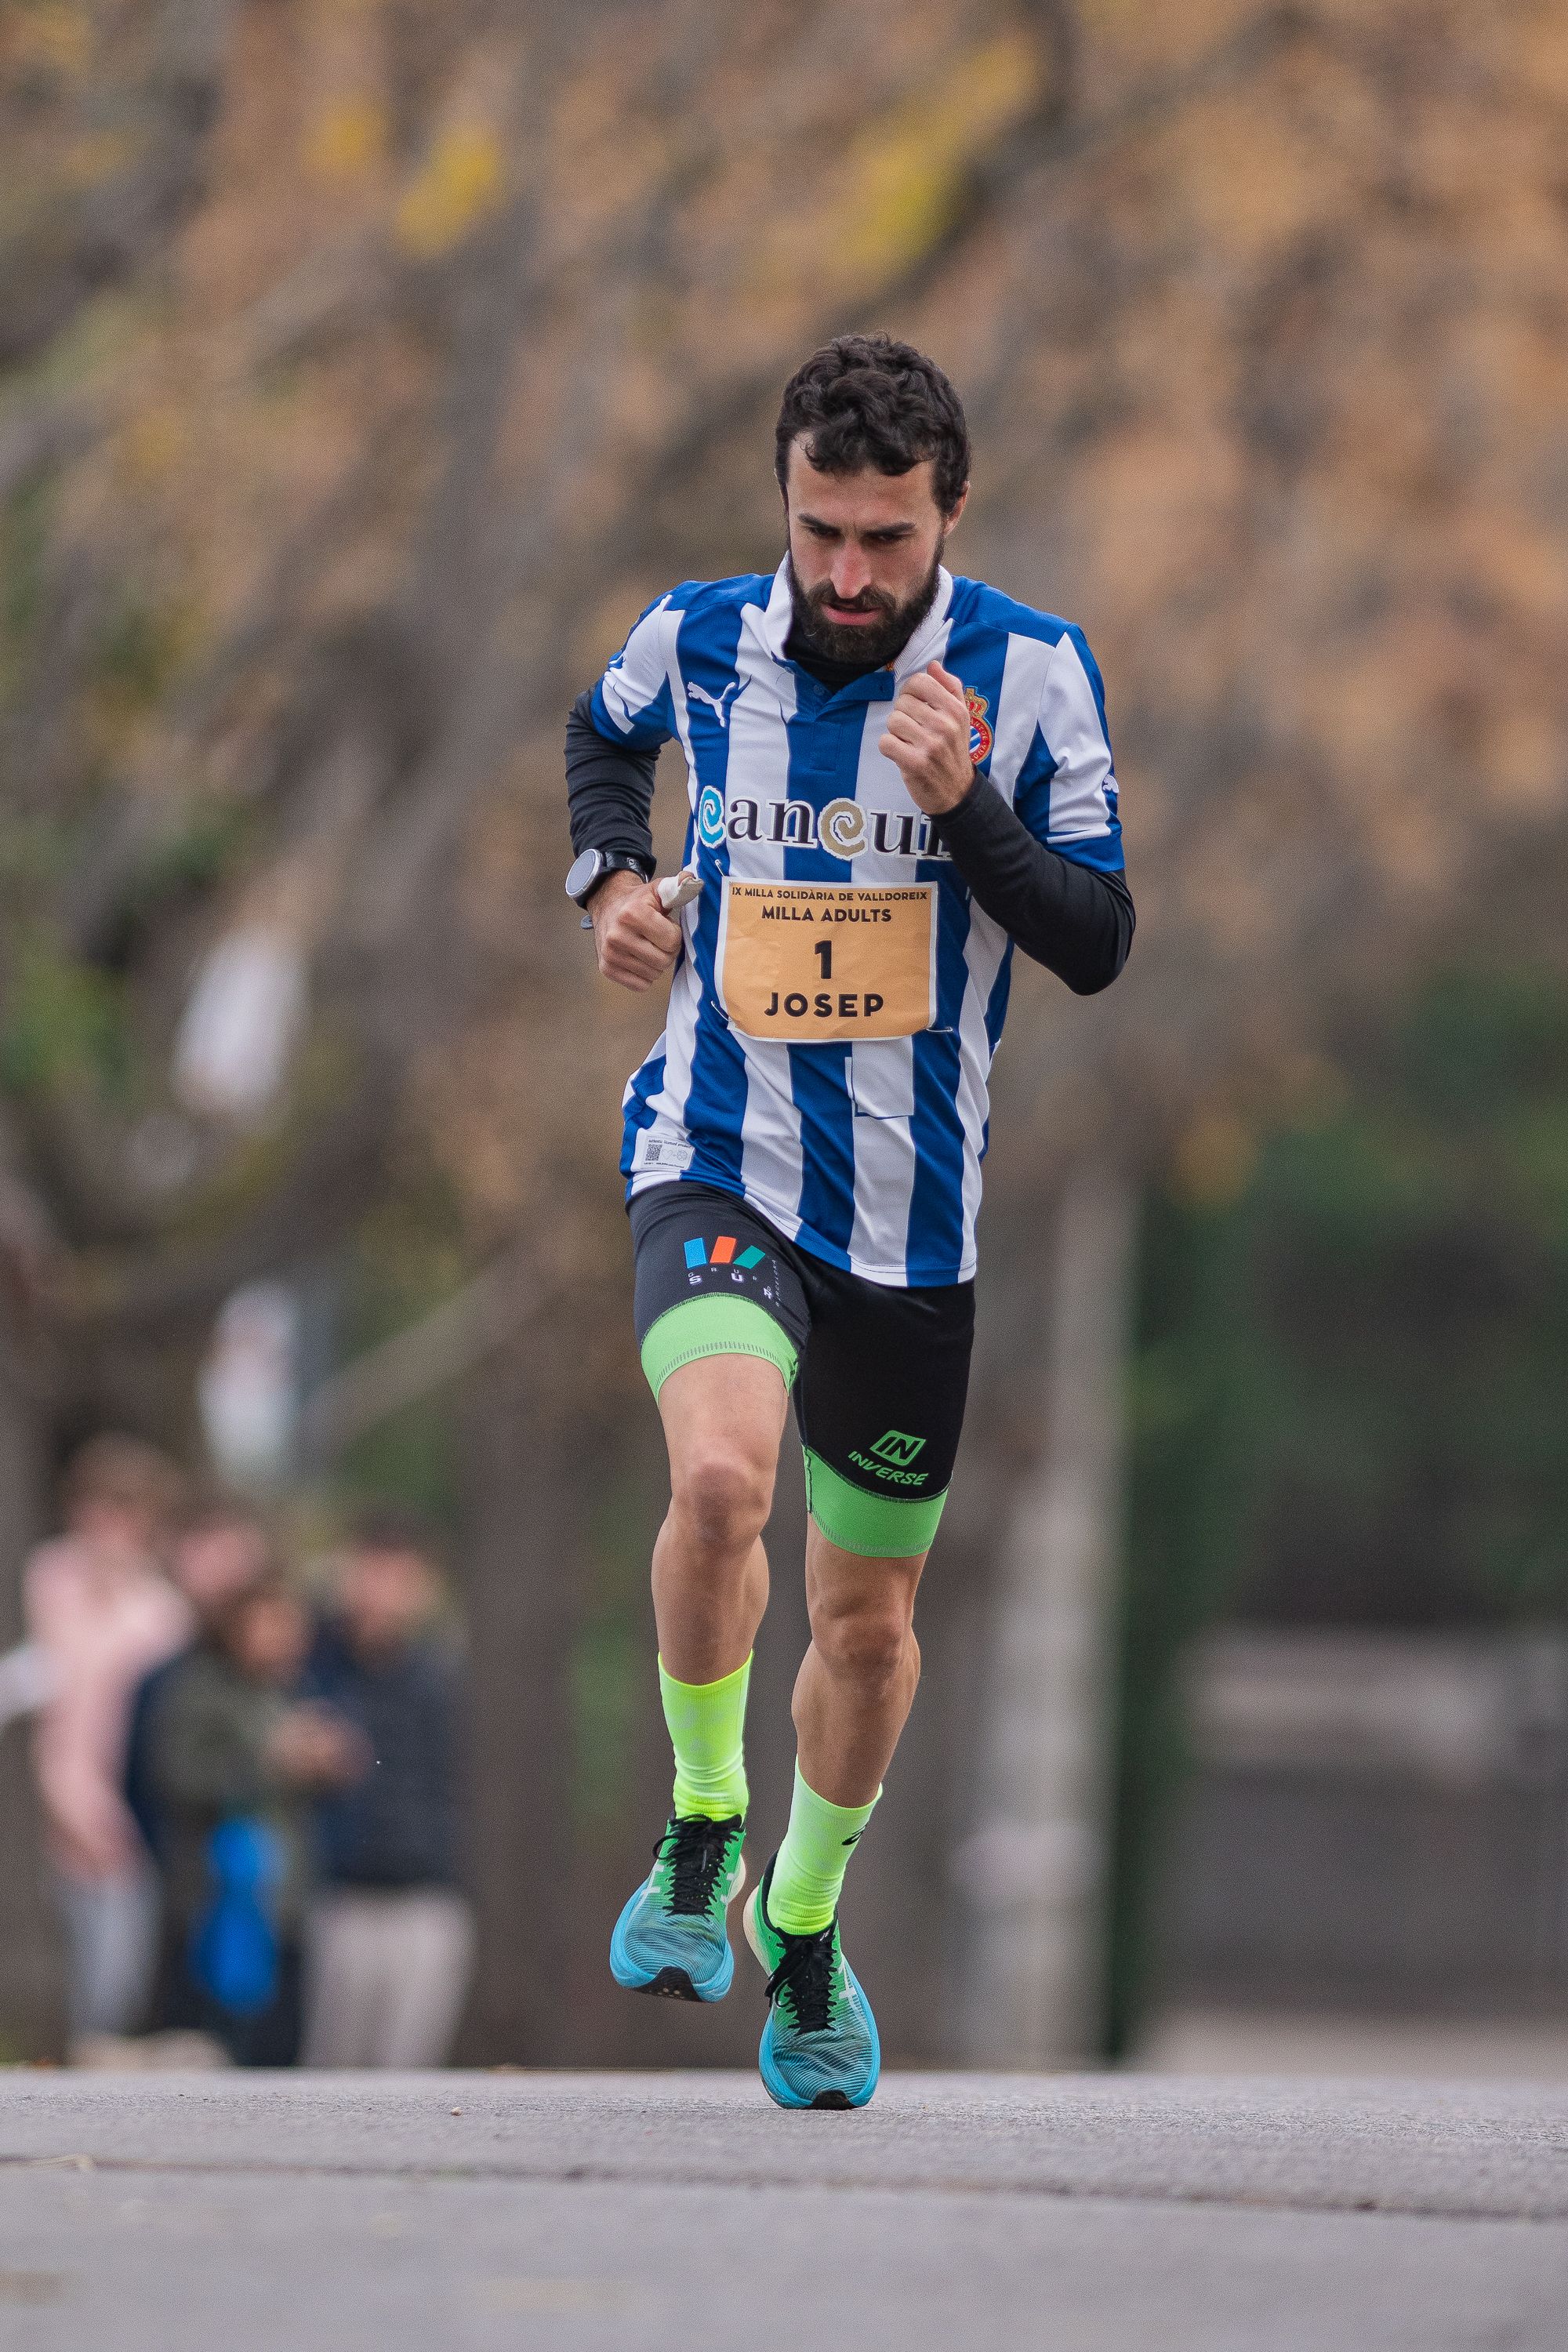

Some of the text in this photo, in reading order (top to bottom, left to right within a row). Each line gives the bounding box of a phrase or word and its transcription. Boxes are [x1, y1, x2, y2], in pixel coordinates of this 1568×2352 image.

[731, 887, 928, 902] IX MILLA SOLIDÀRIA DE VALLDOREIX
[761, 905, 892, 923] MILLA ADULTS
[814, 940, 833, 980] 1
[764, 991, 884, 1018] JOSEP
[848, 1450, 929, 1486] INVERSE
